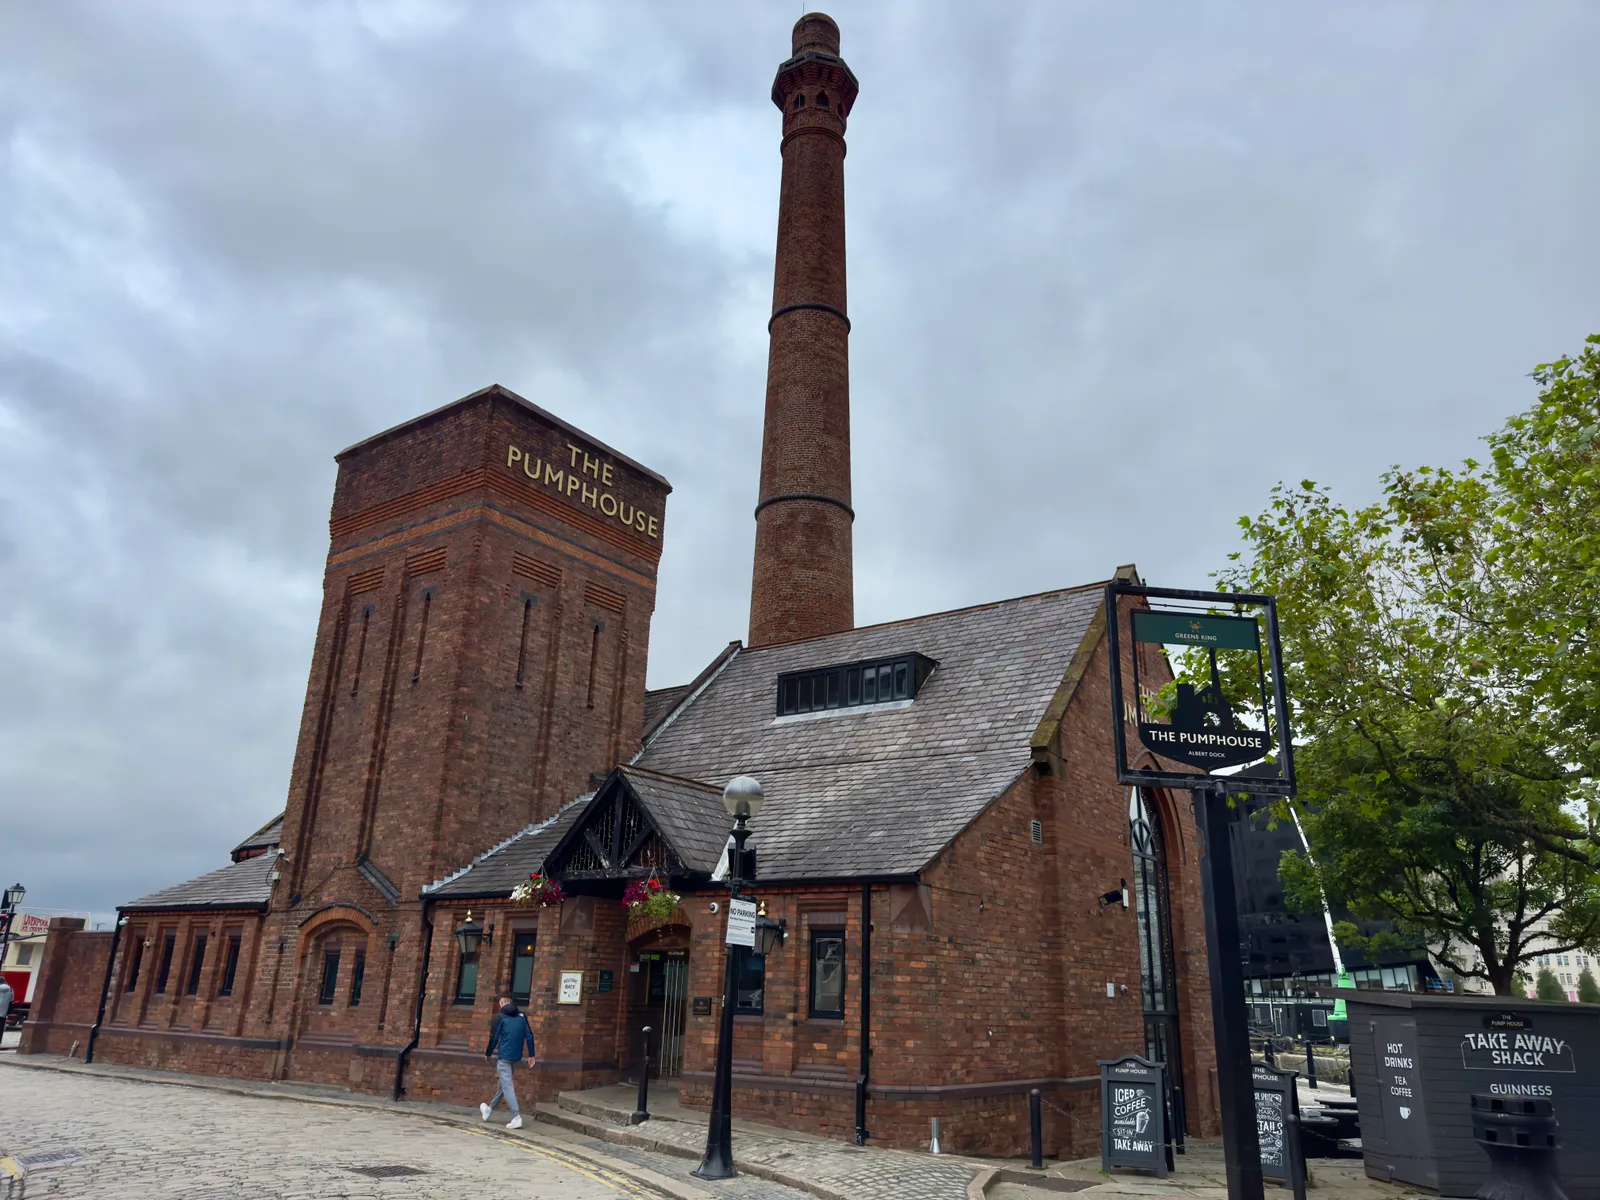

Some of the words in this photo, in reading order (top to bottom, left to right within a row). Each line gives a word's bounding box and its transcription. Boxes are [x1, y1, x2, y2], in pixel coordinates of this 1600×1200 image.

[567, 443, 613, 486] THE
[507, 445, 659, 539] PUMPHOUSE
[1174, 632, 1200, 640] GREENE
[1149, 730, 1176, 742] THE
[1180, 732, 1263, 749] PUMPHOUSE
[730, 907, 737, 916] NO
[737, 909, 755, 918] PARKING
[1386, 1043, 1403, 1054] HOT
[1464, 1033, 1509, 1050] TAKE
[1514, 1033, 1565, 1055] AWAY
[1384, 1056, 1413, 1069] DRINKS
[1491, 1050, 1545, 1066] SHACK
[1252, 1073, 1279, 1081] PHOUSE
[1394, 1075, 1408, 1086] TEA
[1114, 1088, 1135, 1103] ICED
[1390, 1086, 1413, 1098] COFFEE
[1489, 1083, 1553, 1096] GUINNESS
[1114, 1097, 1146, 1116] COFFEE
[1113, 1138, 1131, 1151] TAKE
[1132, 1140, 1153, 1152] AWAY
